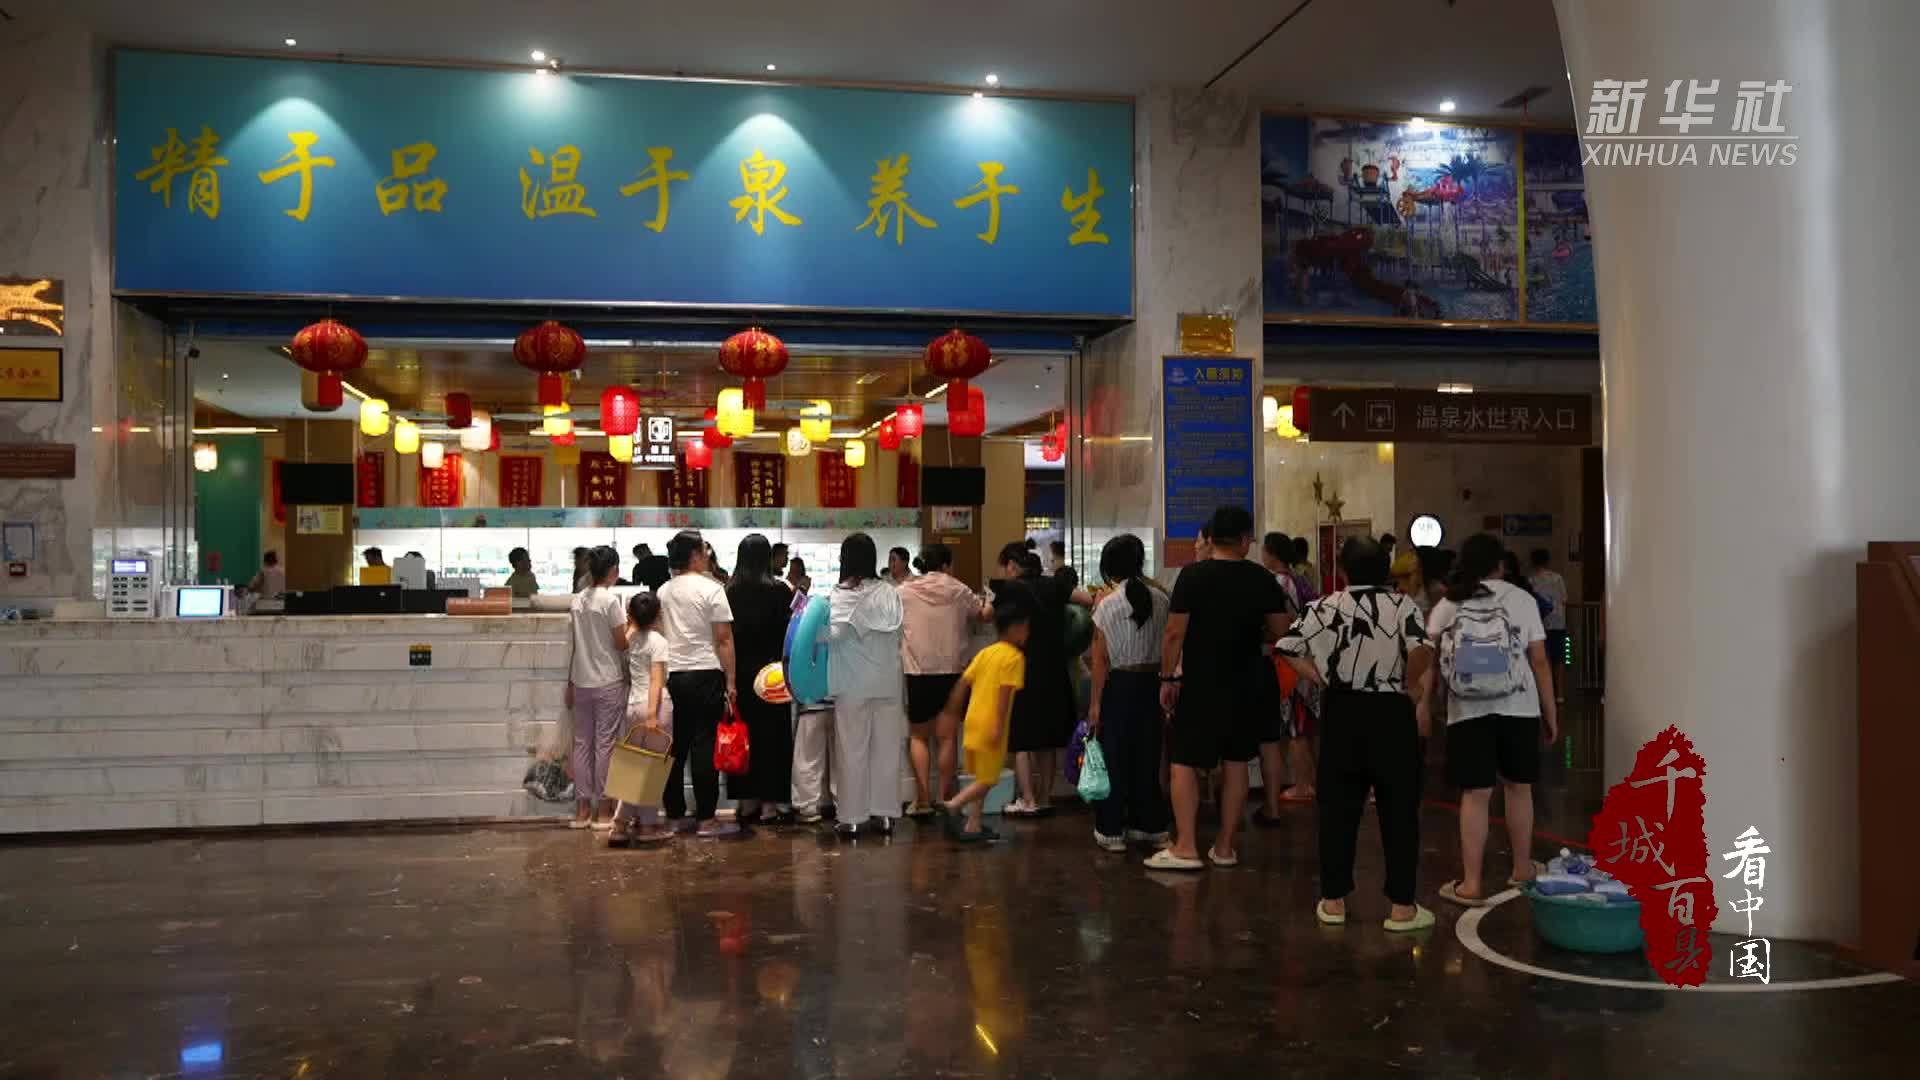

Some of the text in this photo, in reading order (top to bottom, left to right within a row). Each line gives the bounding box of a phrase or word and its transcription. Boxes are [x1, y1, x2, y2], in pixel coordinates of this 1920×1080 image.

[1416, 405, 1576, 431] 温泉水世界入口
